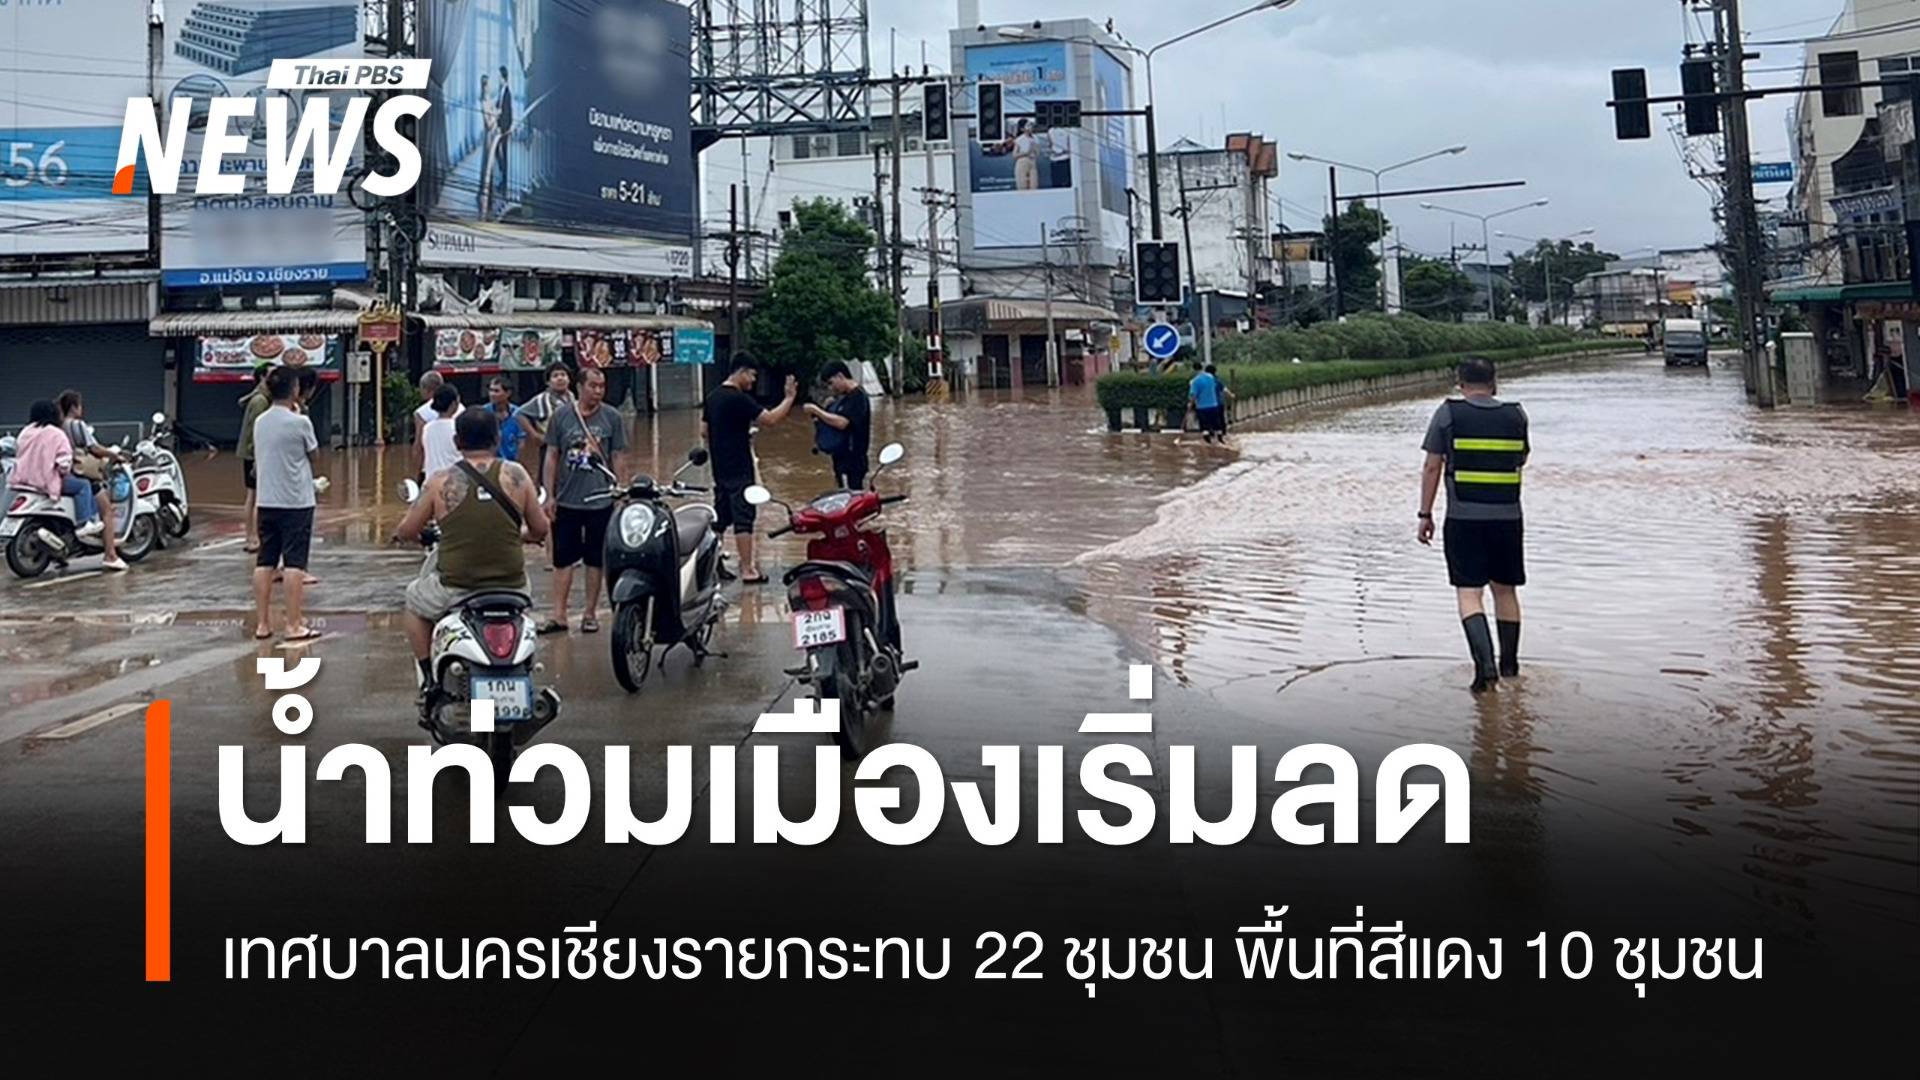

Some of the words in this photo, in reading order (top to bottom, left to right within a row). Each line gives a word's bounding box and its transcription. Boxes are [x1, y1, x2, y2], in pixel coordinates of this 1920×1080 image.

[619, 181, 645, 204] 5-21
[428, 230, 476, 252] SUPALAI
[200, 269, 252, 284] อ.แม่จัน
[256, 267, 328, 282] จ.เชียงราย
